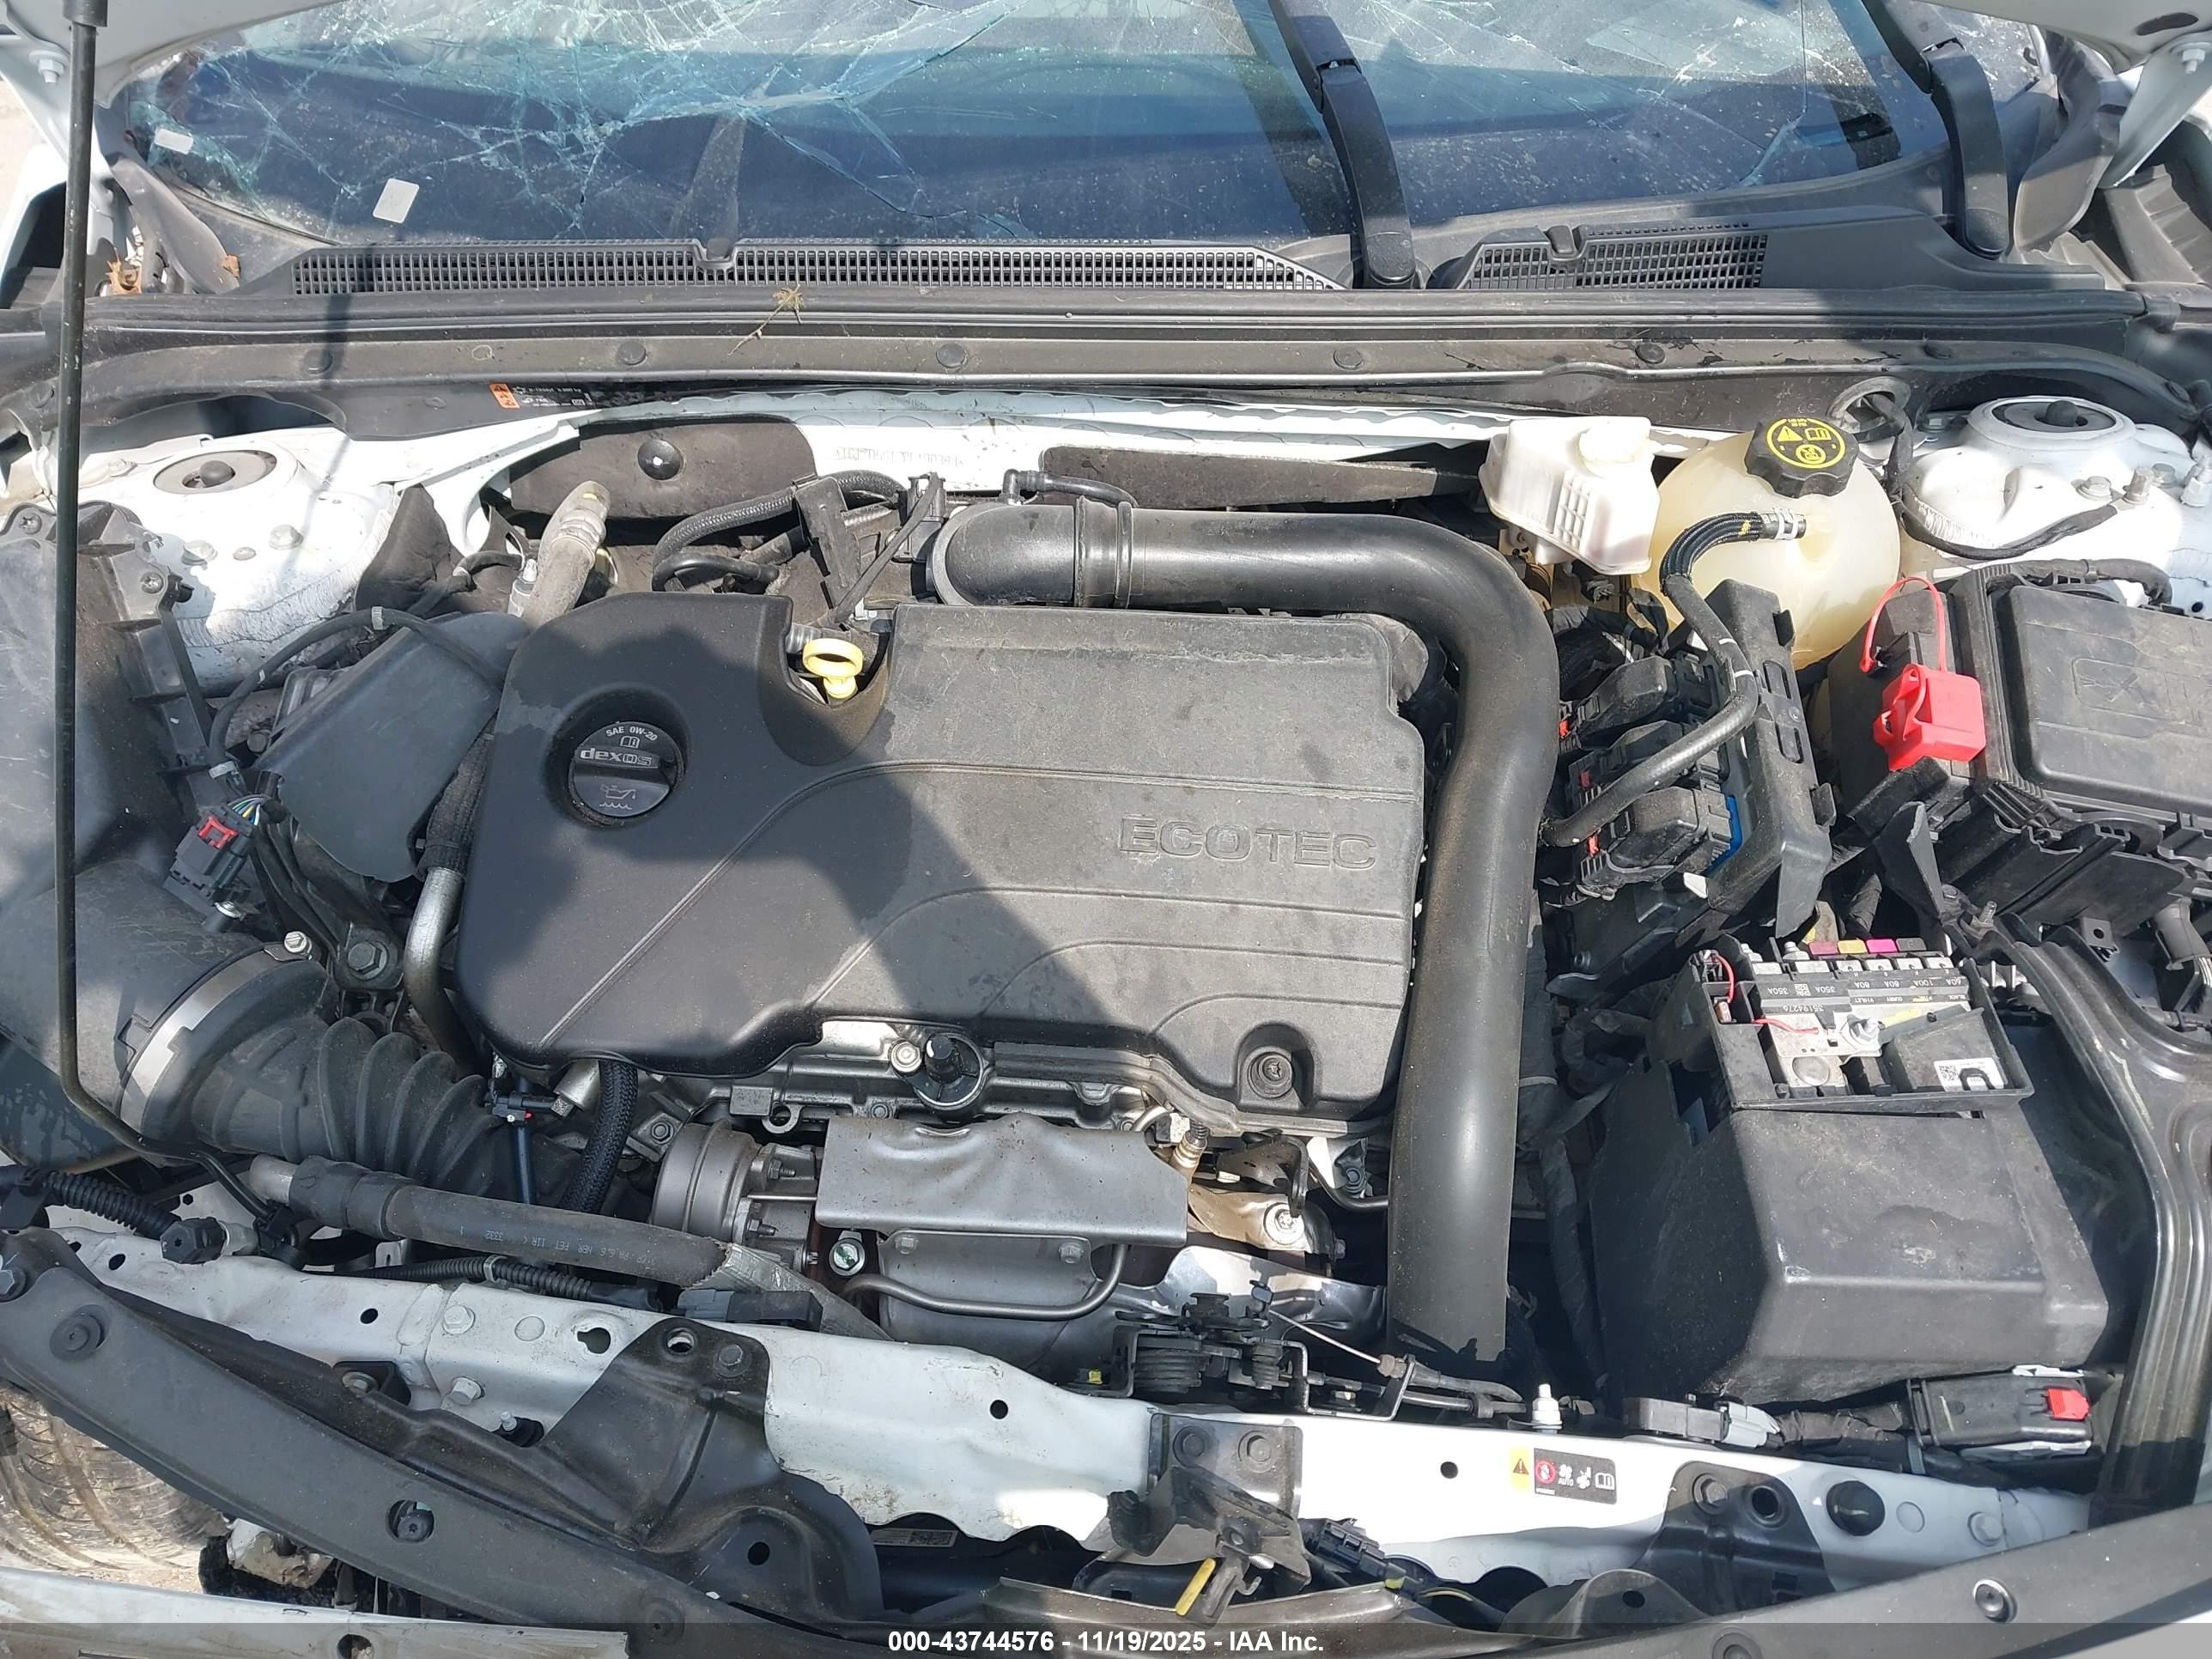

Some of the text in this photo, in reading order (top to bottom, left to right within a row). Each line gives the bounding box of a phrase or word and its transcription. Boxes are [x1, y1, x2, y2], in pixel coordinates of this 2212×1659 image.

[605, 726, 658, 741] SAE 0W-20
[580, 748, 653, 766] dexos
[1119, 817, 1376, 870] ECOTEC
[1767, 988, 1789, 996] 350A
[555, 1239, 569, 1251] PET
[1558, 1478, 1574, 1486] AUTO
